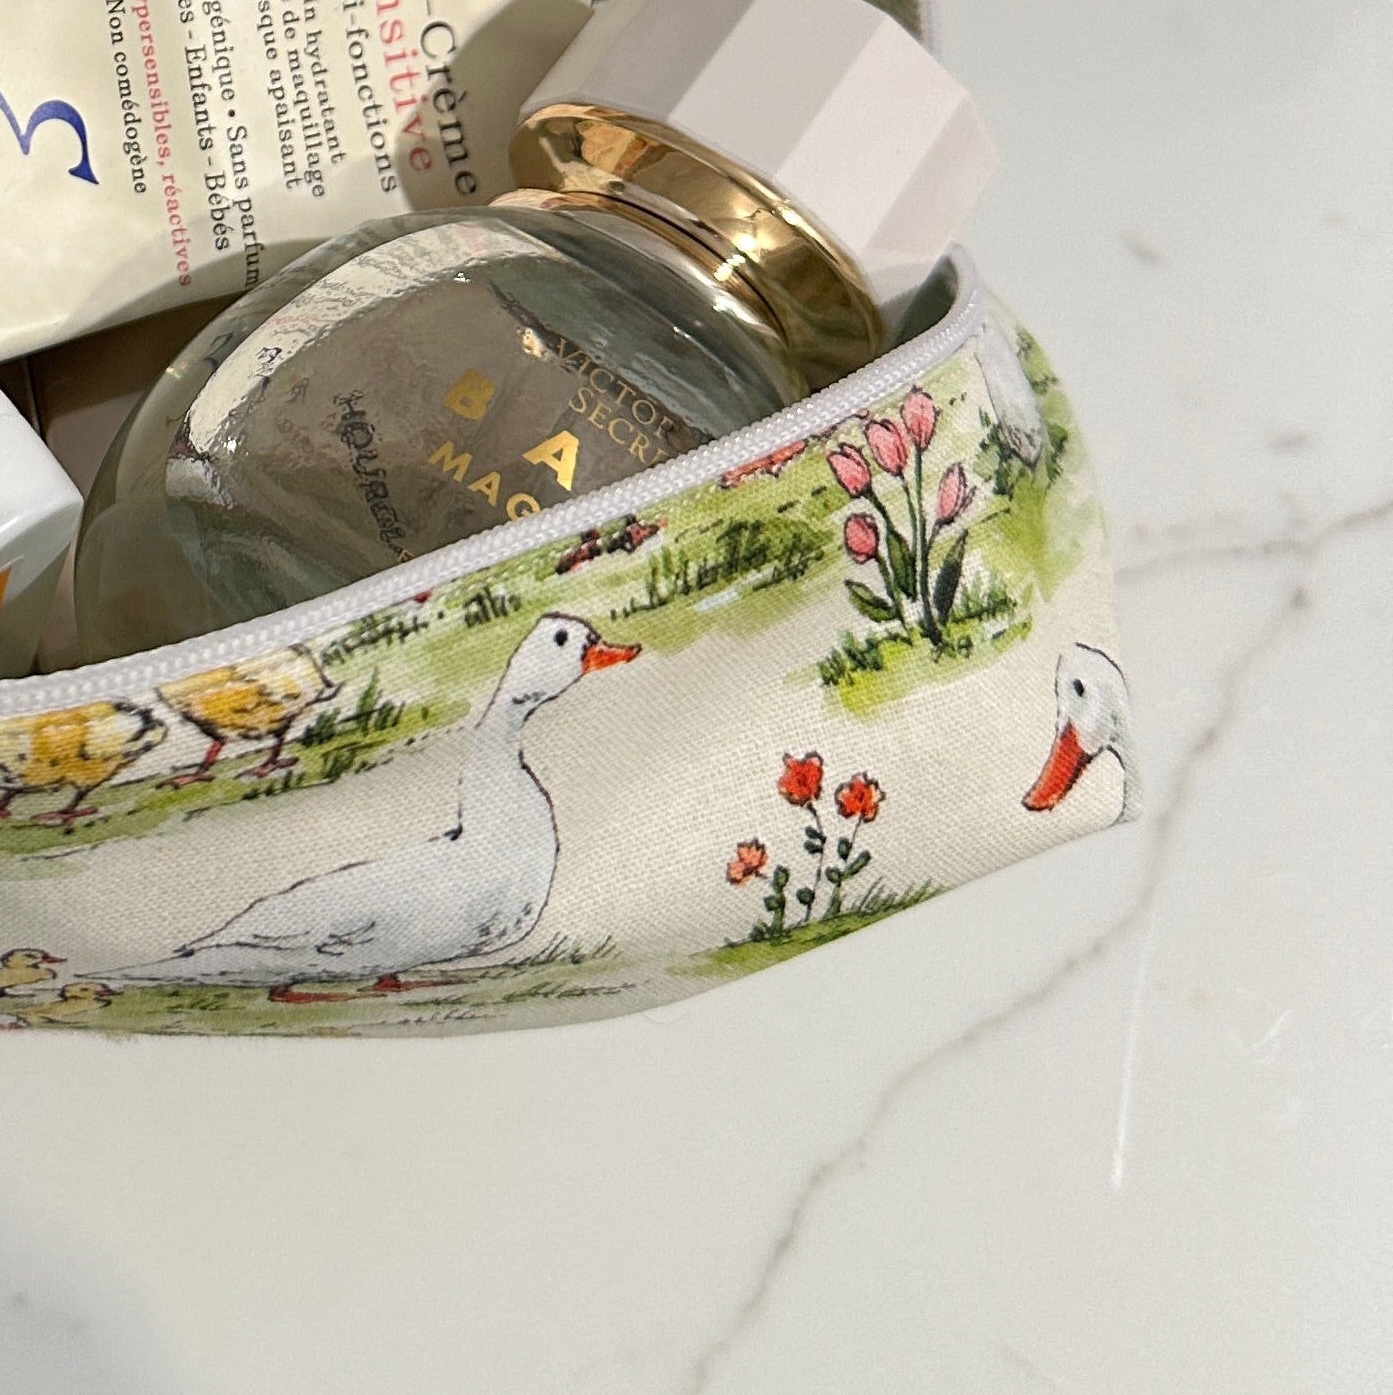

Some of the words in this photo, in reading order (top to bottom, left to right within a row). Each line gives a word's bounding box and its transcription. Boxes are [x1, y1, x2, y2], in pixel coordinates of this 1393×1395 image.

[281, 10, 299, 40] de
[113, 51, 147, 195] comédogène
[183, 44, 216, 151] Enfants
[202, 172, 233, 251] Bébés
[224, 126, 248, 190] Sans
[266, 69, 302, 190] apaisant
[286, 50, 325, 199] maquillage
[302, 30, 345, 165] hydratant
[160, 173, 191, 287] réactives
[232, 197, 264, 288] parfum
